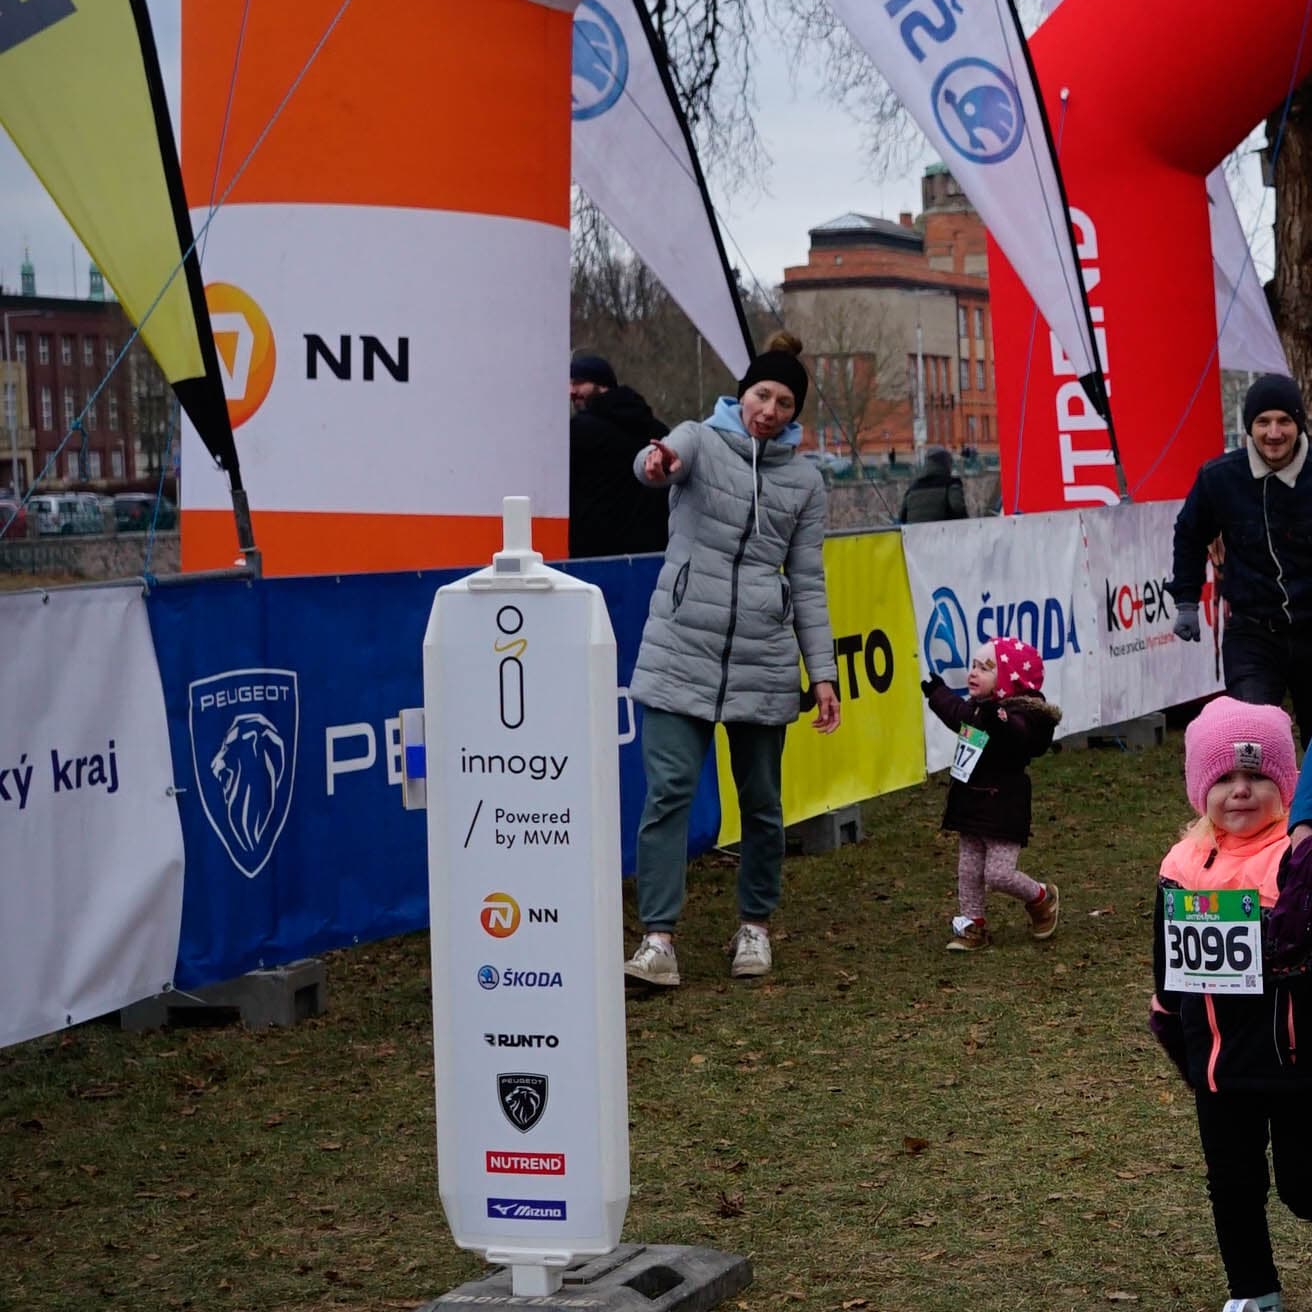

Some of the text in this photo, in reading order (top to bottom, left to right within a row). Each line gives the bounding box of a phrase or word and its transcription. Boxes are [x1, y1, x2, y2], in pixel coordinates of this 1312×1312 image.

[304, 333, 410, 383] NN
[976, 591, 1081, 661] ŠKODA
[200, 684, 290, 711] PEUGEOT
[50, 739, 119, 793] kraj
[461, 747, 568, 780] innogy
[495, 808, 571, 824] Powered
[496, 830, 570, 848] by MVM
[528, 908, 559, 923] NN
[1168, 925, 1253, 972] 3096
[503, 967, 563, 988] ŠKODA
[498, 1033, 559, 1049] RUNTO
[490, 1156, 562, 1172] NUTREND
